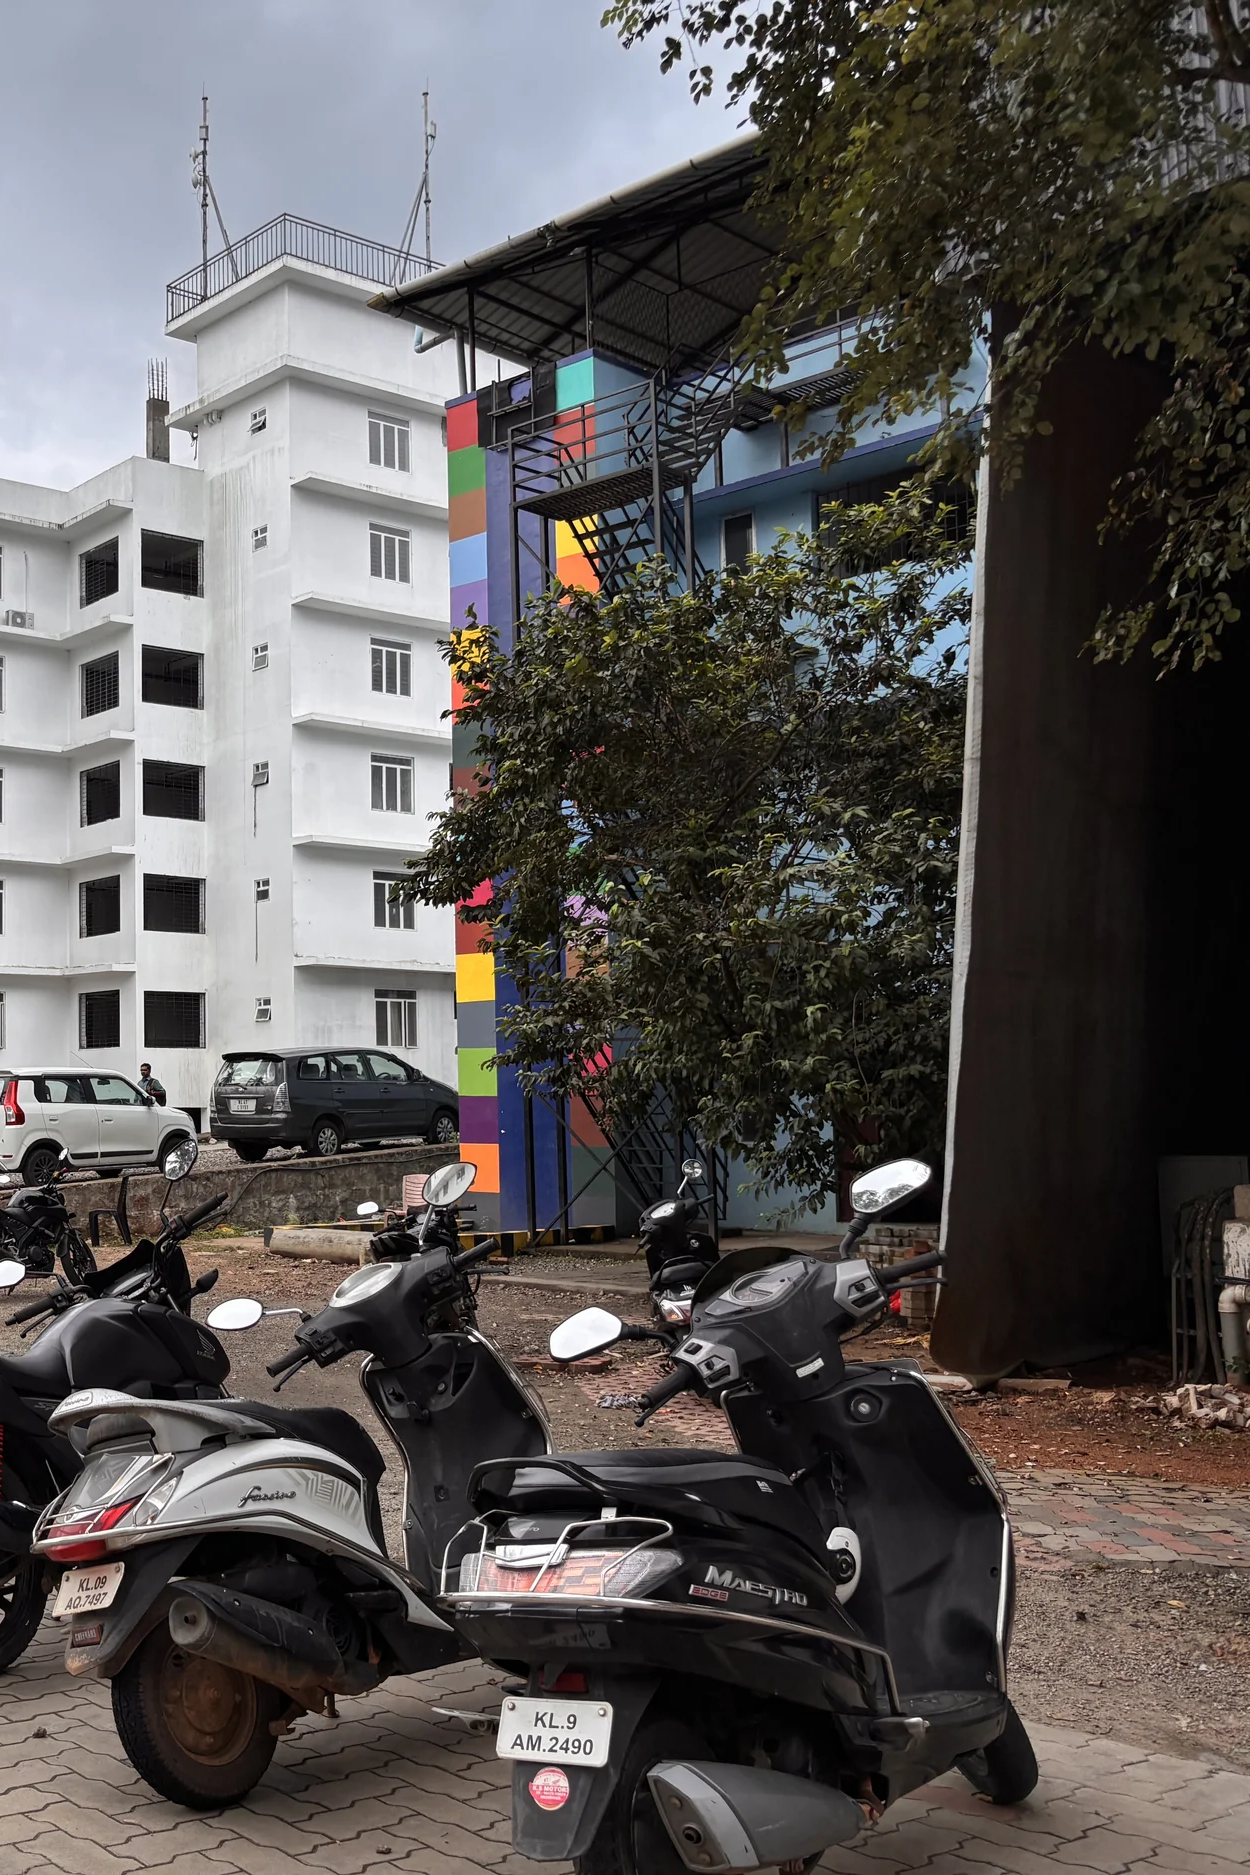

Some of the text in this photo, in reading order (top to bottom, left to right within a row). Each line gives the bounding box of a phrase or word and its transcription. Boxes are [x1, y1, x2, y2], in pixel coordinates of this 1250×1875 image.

[77, 1575, 107, 1593] KL.09
[691, 1585, 728, 1601] EDGE
[64, 1591, 108, 1611] AQ.7497
[533, 1711, 578, 1730] KL.9
[510, 1733, 594, 1756] AM.2490
